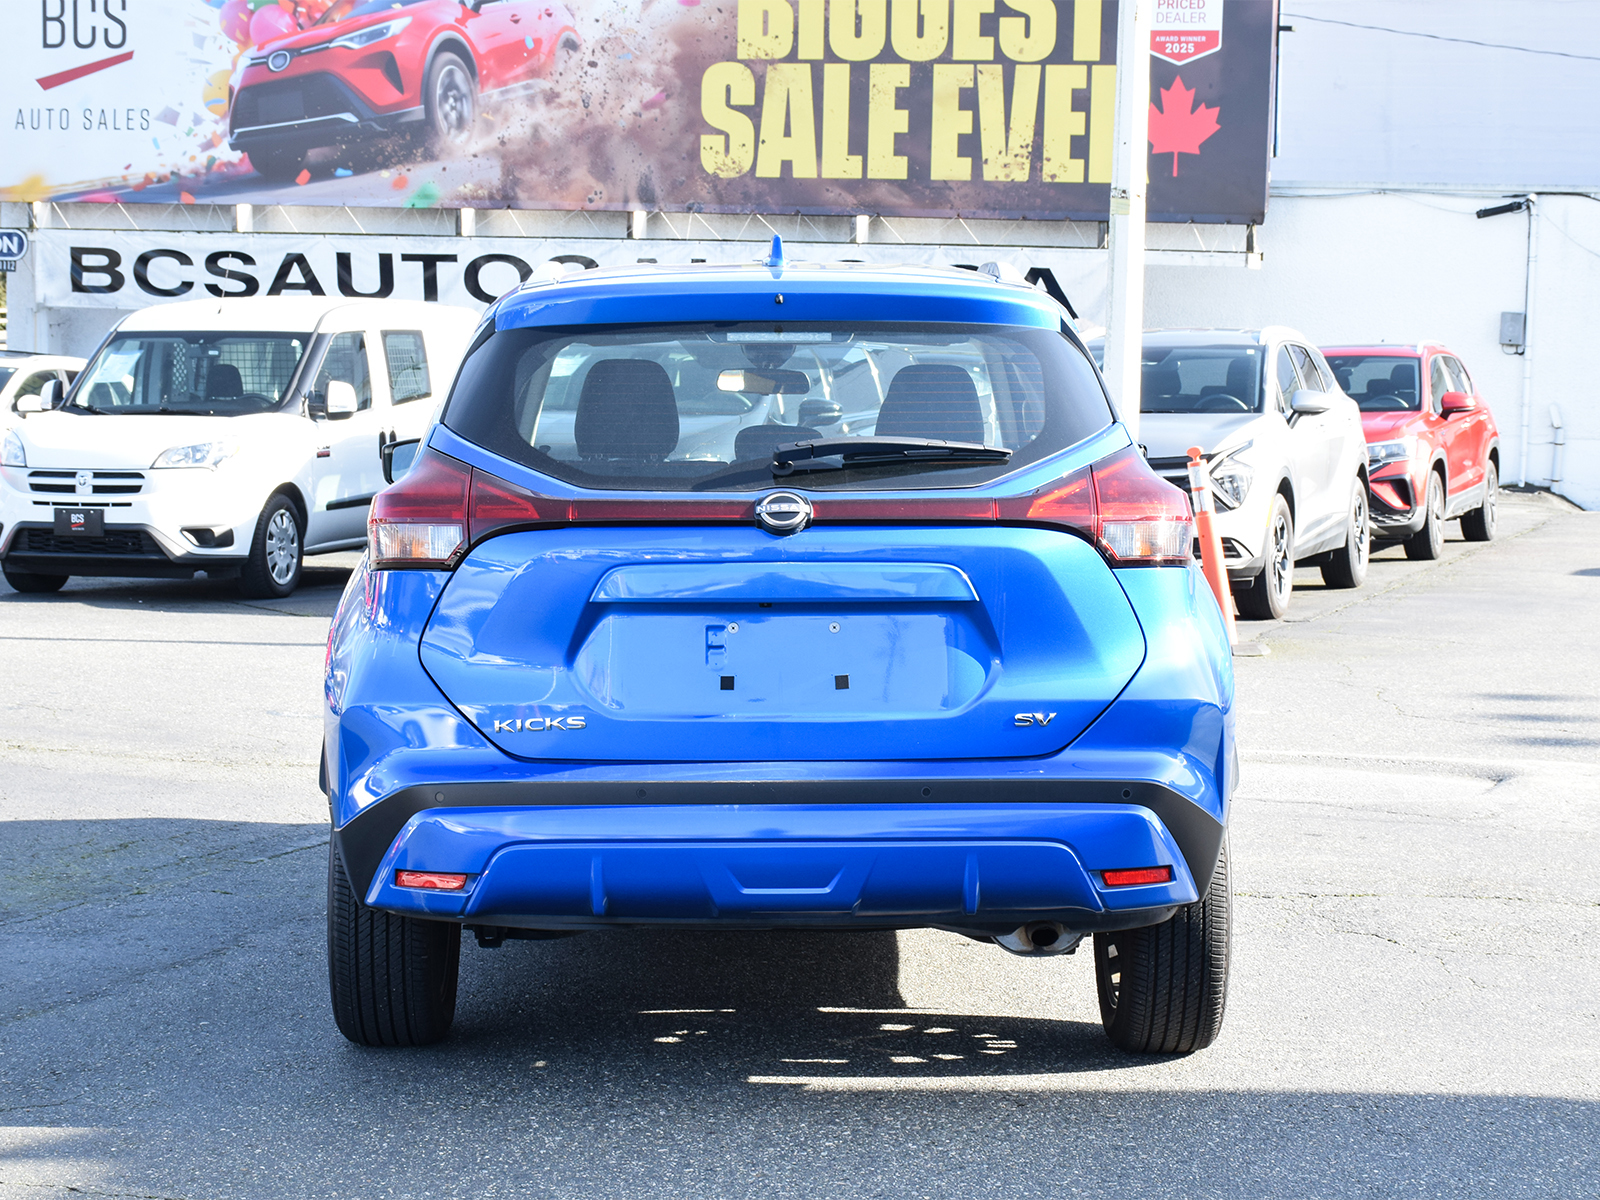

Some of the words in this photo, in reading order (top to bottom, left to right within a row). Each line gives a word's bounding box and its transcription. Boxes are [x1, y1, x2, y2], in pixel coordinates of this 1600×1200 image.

[1157, 0, 1206, 10] PRICED
[42, 0, 127, 49] BCS
[1156, 12, 1207, 23] DEALER
[1165, 43, 1195, 53] 2025
[15, 108, 69, 130] AUTO
[83, 108, 150, 131] SALES
[700, 61, 911, 179] SALE
[71, 513, 84, 523] BCS
[493, 716, 587, 733] KICKS
[1014, 712, 1057, 727] SV
